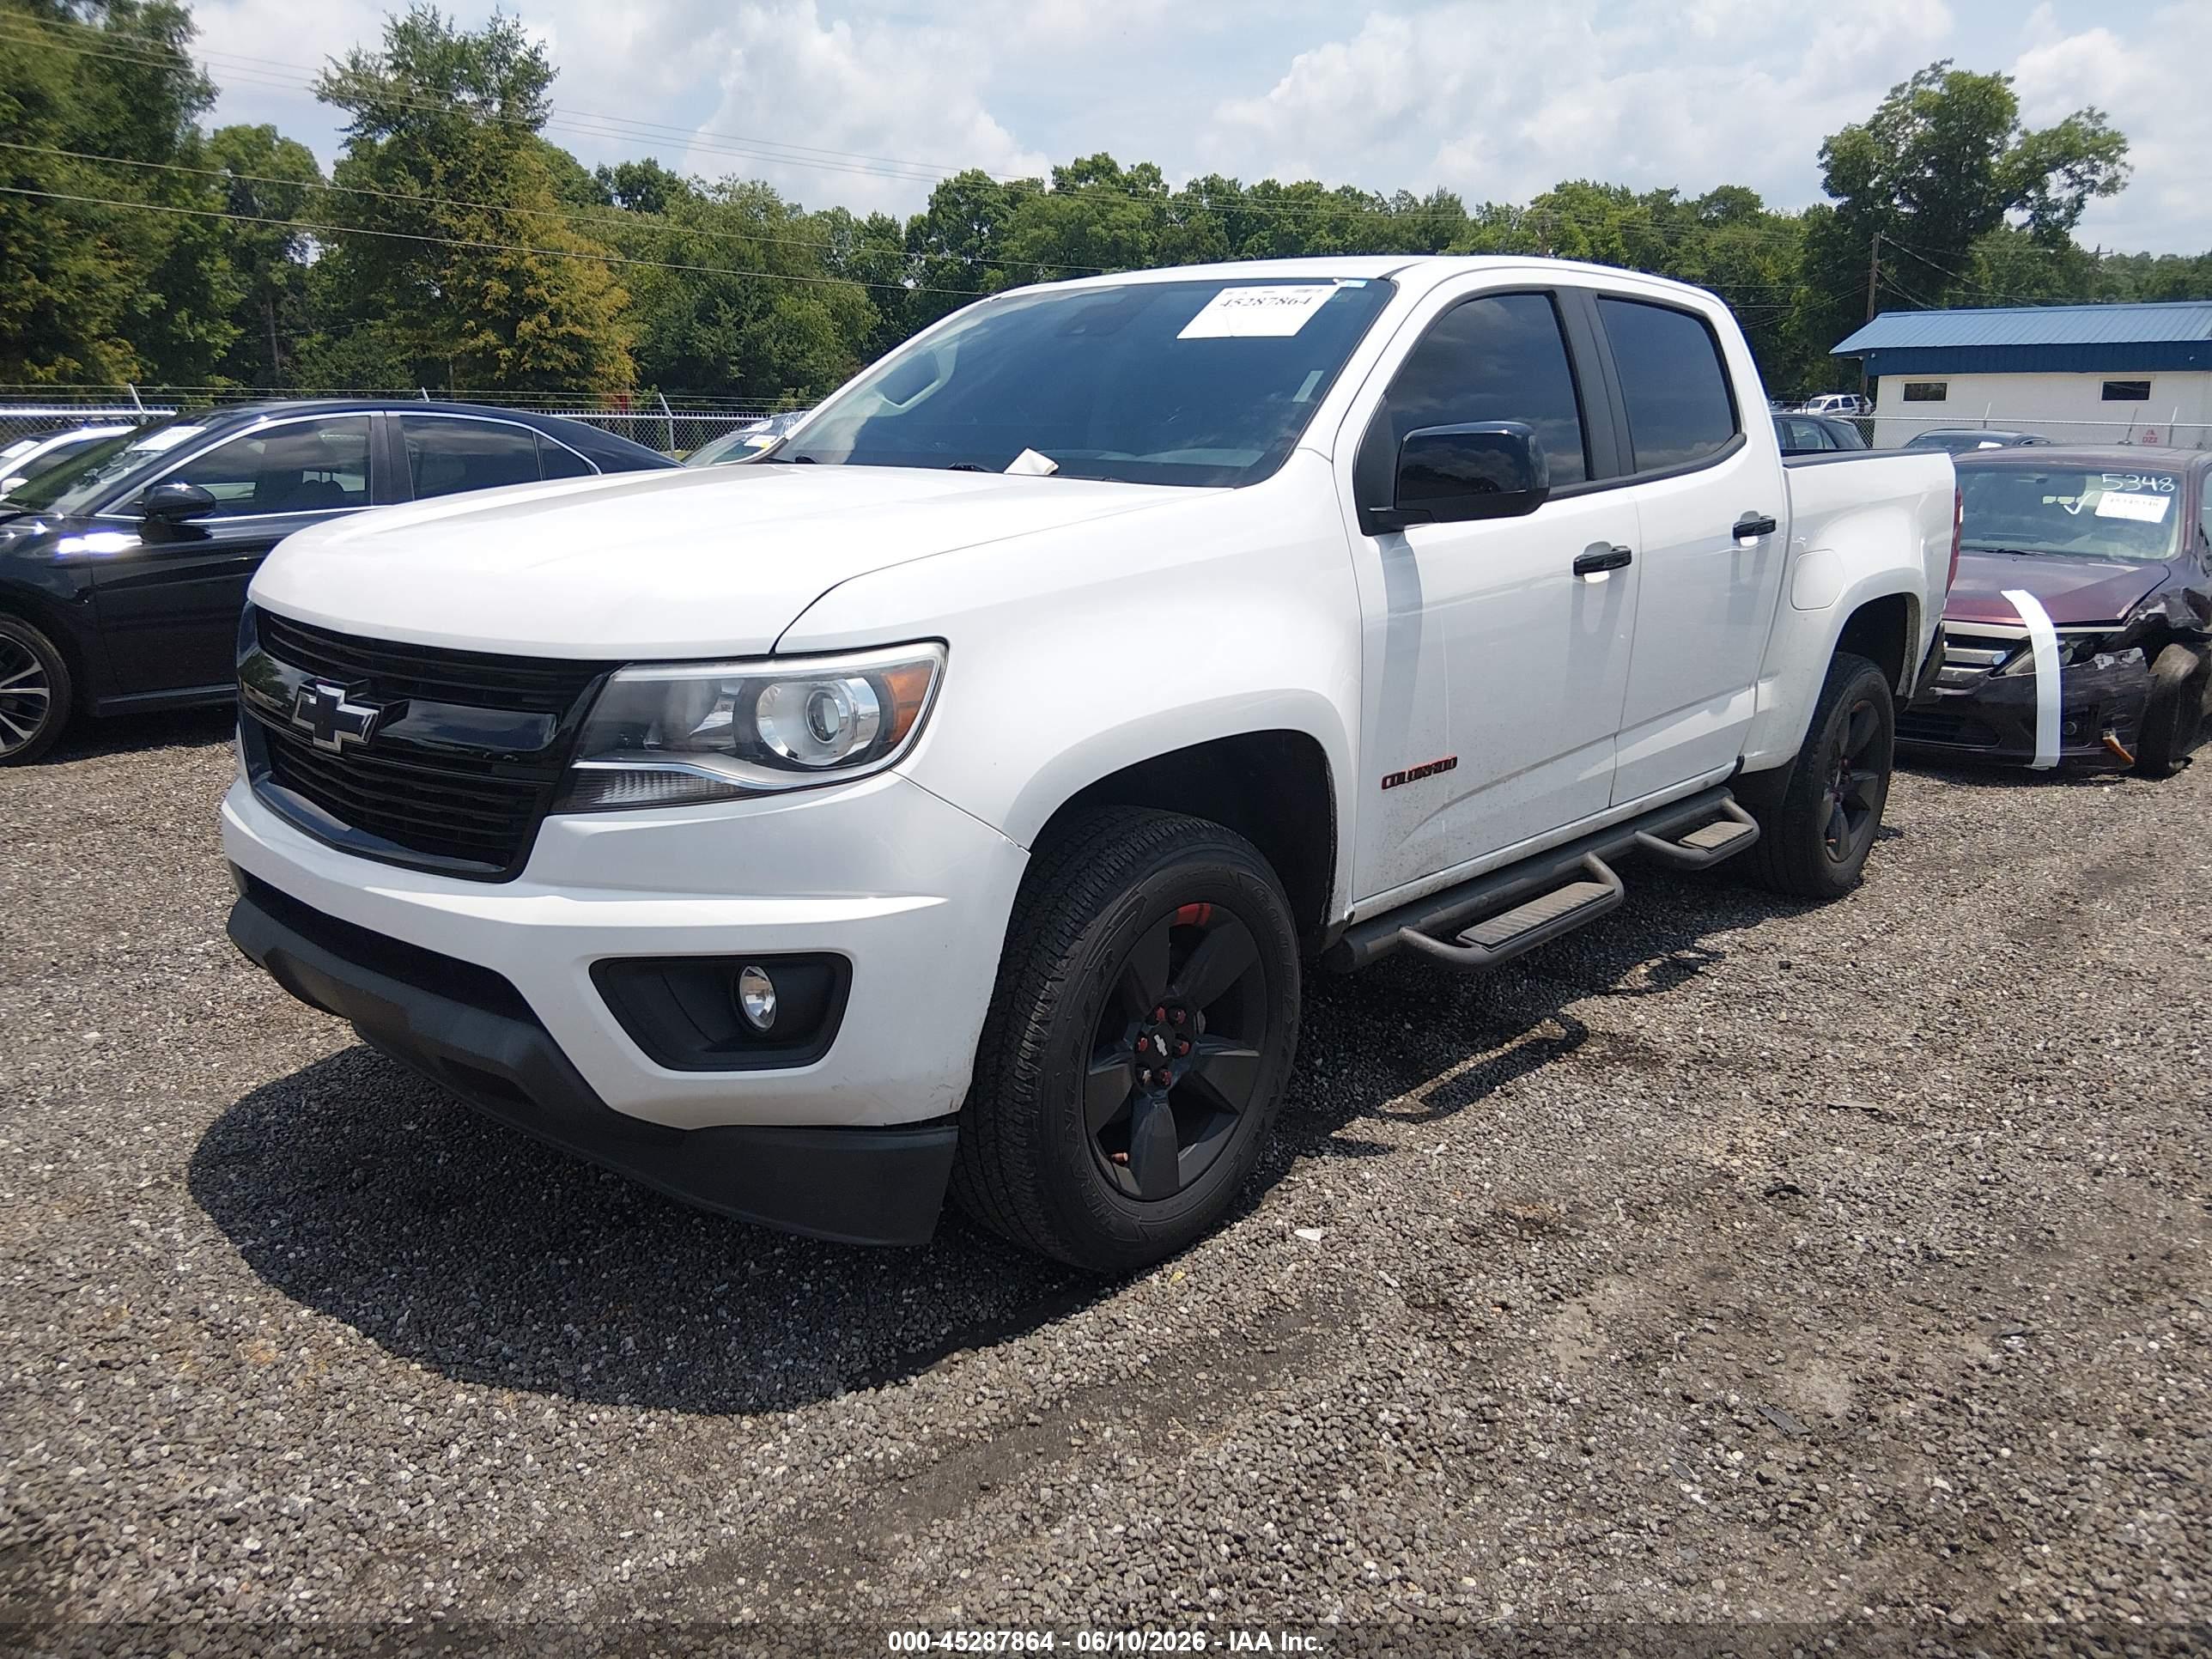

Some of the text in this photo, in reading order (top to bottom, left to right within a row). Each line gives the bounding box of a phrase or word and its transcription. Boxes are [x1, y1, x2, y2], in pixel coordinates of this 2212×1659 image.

[1219, 295, 1313, 307] 45287864
[2100, 473, 2175, 492] 5348
[1382, 756, 1458, 790] COLORADO
